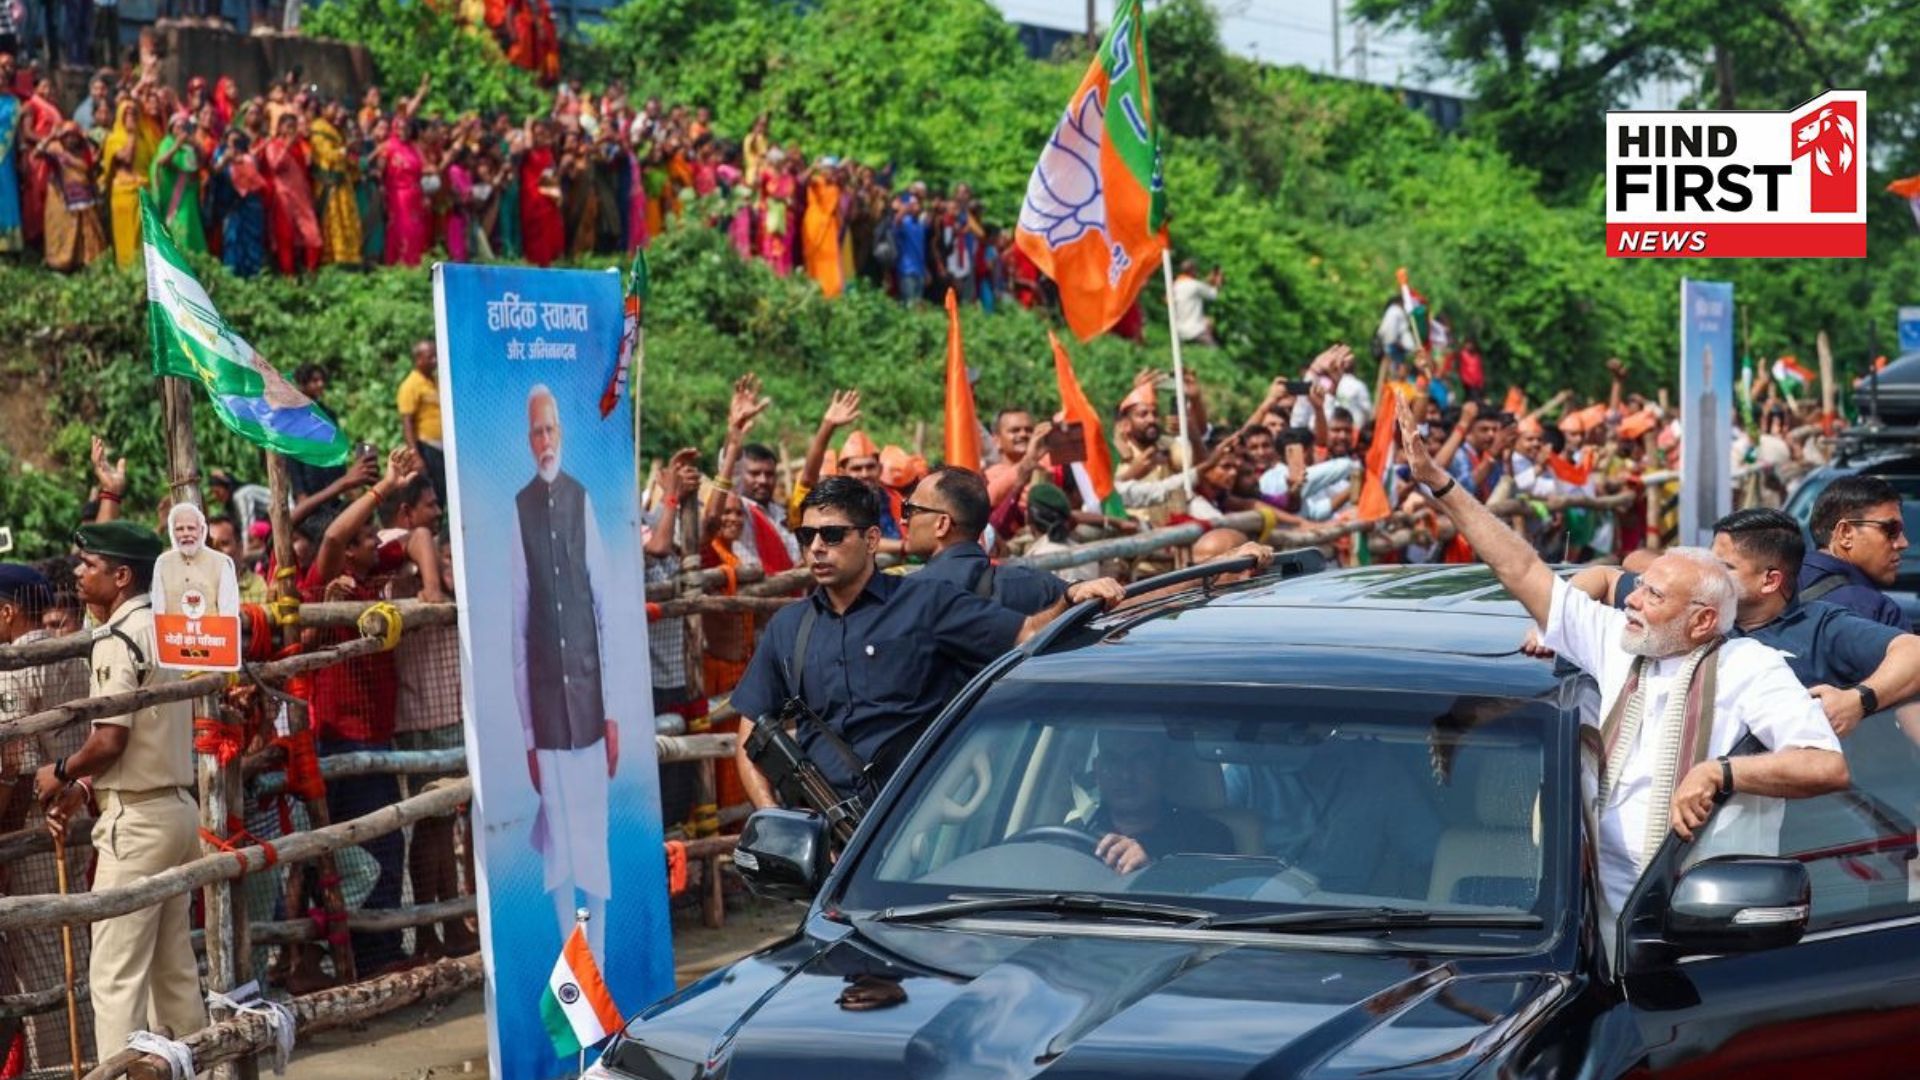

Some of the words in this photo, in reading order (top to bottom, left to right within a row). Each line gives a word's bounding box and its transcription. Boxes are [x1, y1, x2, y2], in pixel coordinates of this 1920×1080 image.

[486, 291, 537, 331] हार्दिक
[540, 302, 588, 331] स्वागत
[506, 338, 525, 361] और
